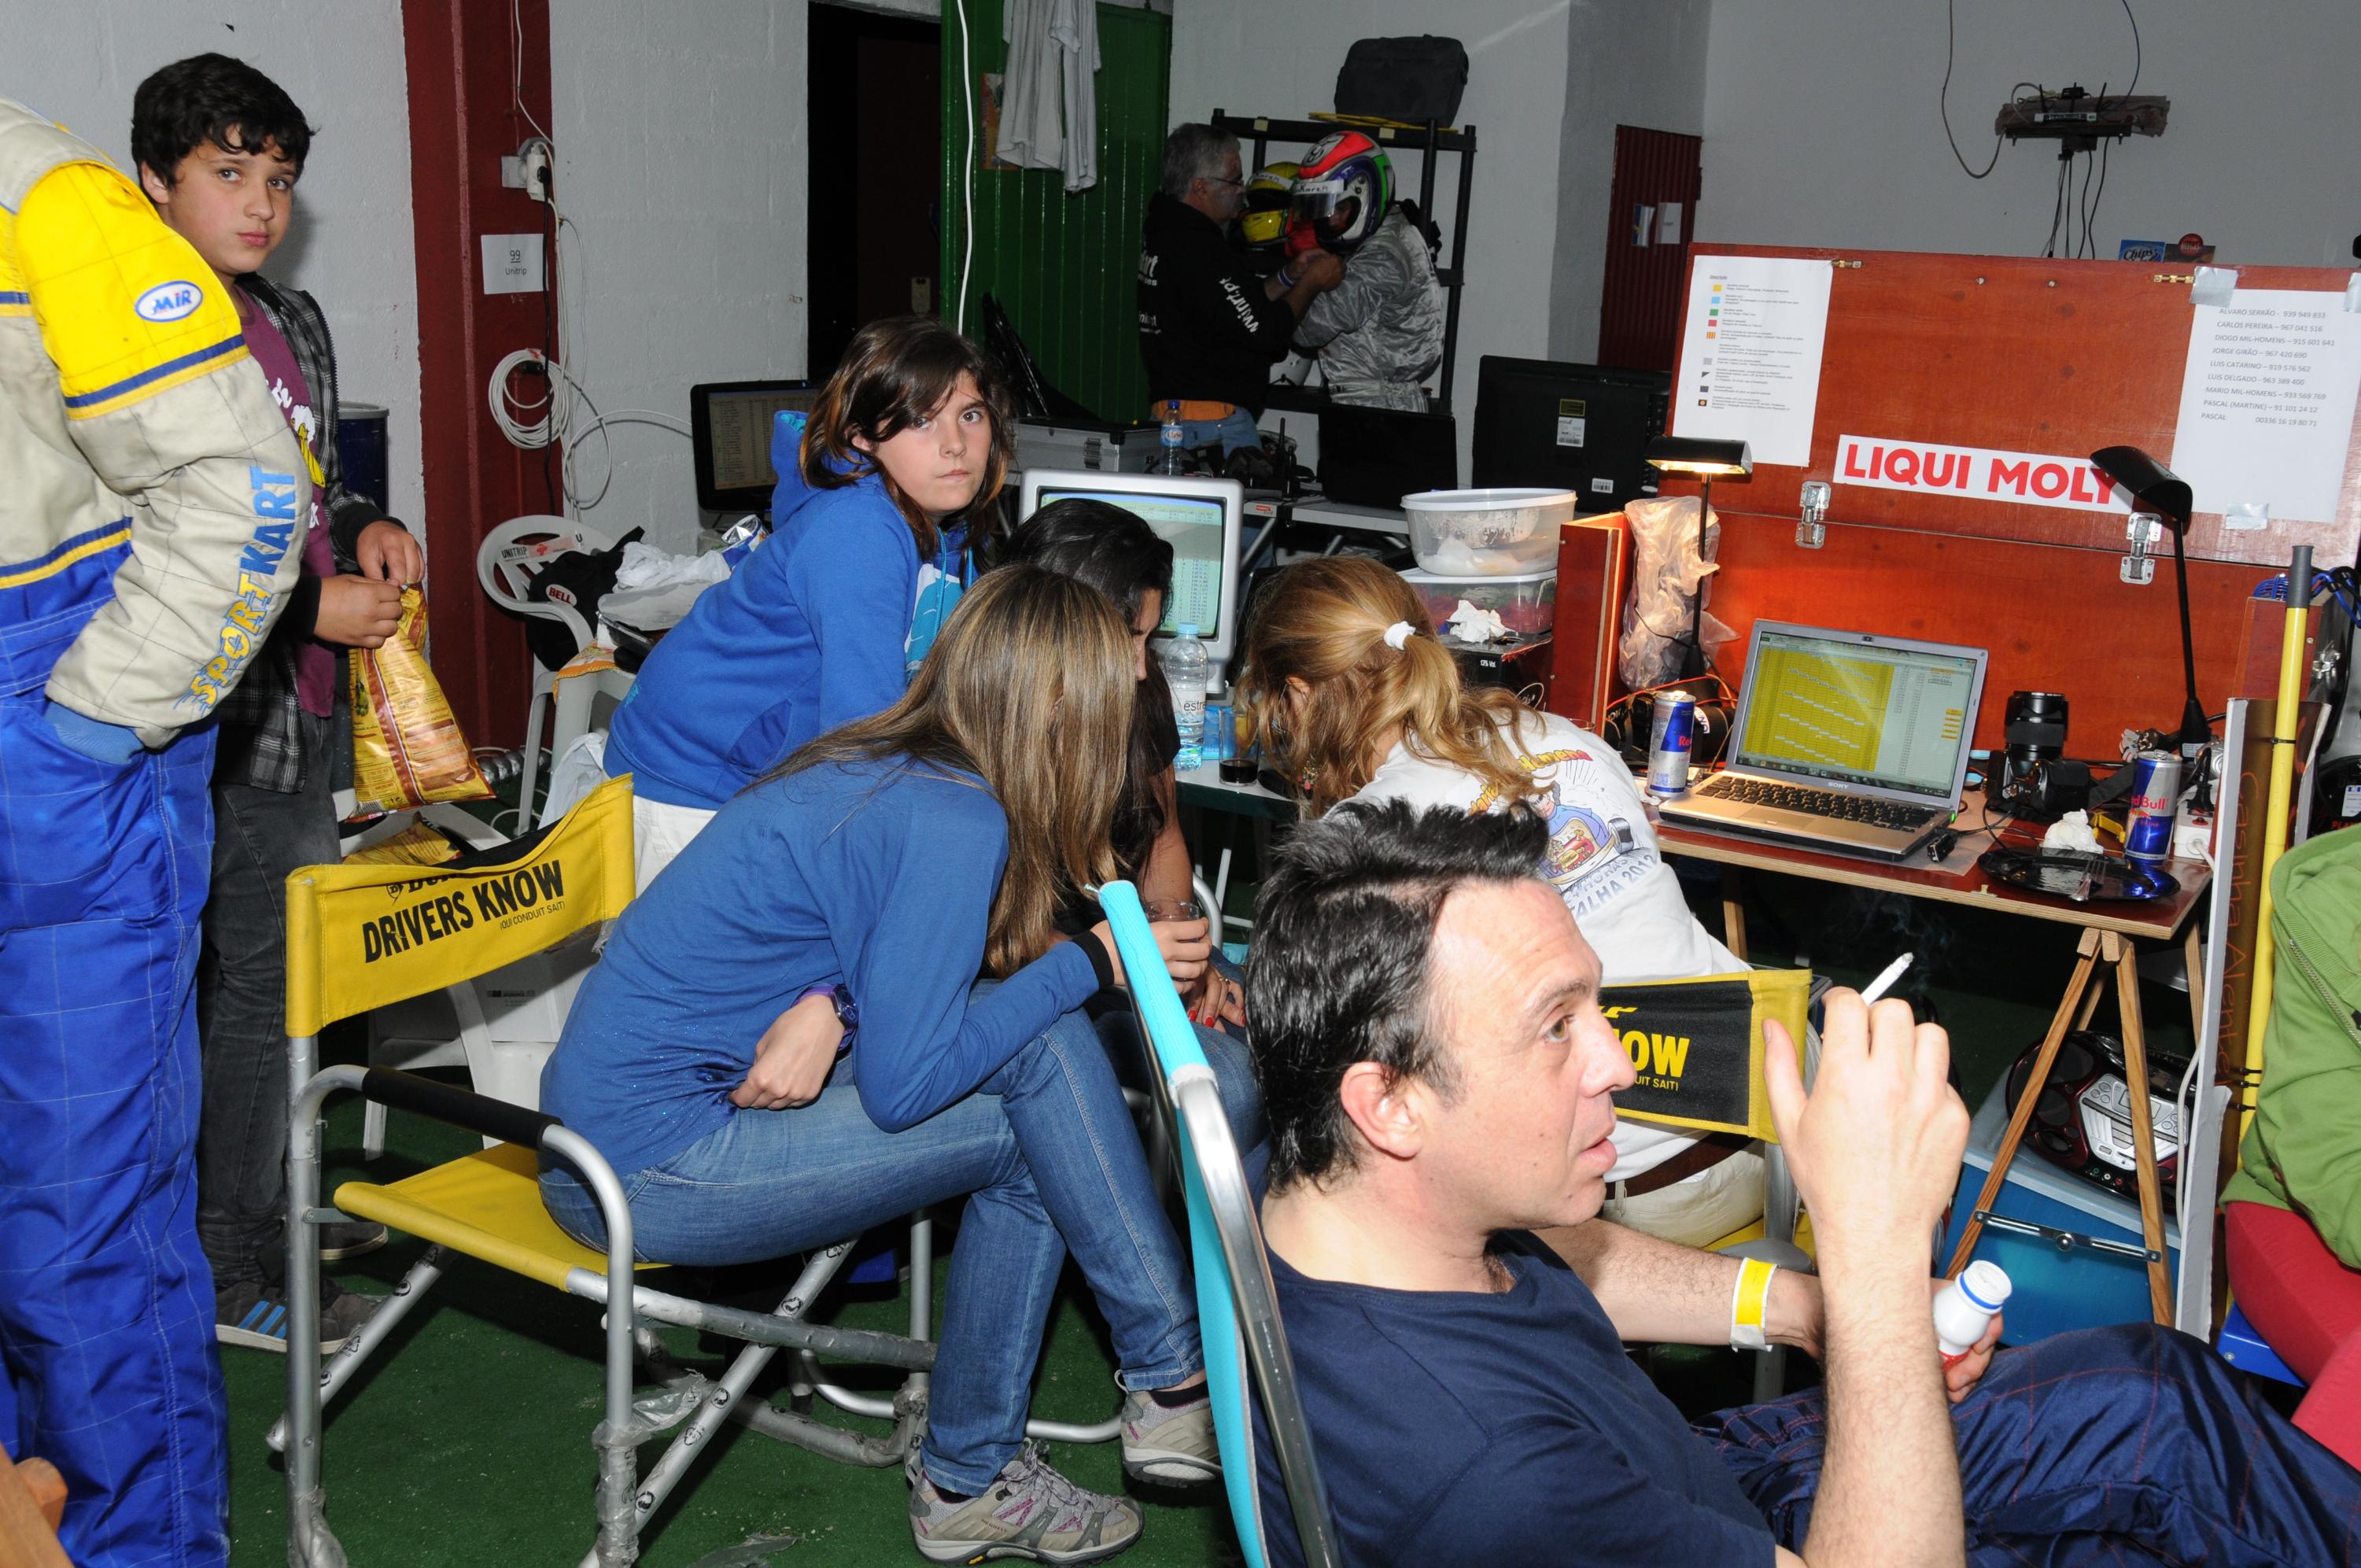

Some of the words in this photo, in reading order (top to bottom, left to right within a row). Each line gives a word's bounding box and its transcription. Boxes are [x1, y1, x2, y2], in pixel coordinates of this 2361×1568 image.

[509, 249, 521, 263] 99
[2124, 248, 2154, 260] Chips
[505, 267, 527, 276] Unitrip
[2240, 335, 2285, 344] MIL-HOMENS
[2230, 388, 2277, 397] MIL-HOMENS
[2230, 401, 2267, 411] (MARTINE)
[1844, 444, 1972, 489] LIQUI
[1987, 458, 2118, 505] MOLY
[501, 546, 528, 559] UNITRIP
[548, 586, 572, 604] BELL
[2228, 771, 2260, 928] Casinha
[1581, 858, 1629, 893] HORAS
[1621, 854, 1660, 881] 2012
[362, 890, 474, 964] DRIVERS
[471, 859, 566, 922] KNOW
[513, 909, 545, 926] CONDUIT
[547, 901, 566, 917] SAIT)
[1613, 1028, 1691, 1078] OW
[1653, 1077, 1680, 1091] SAIT)
